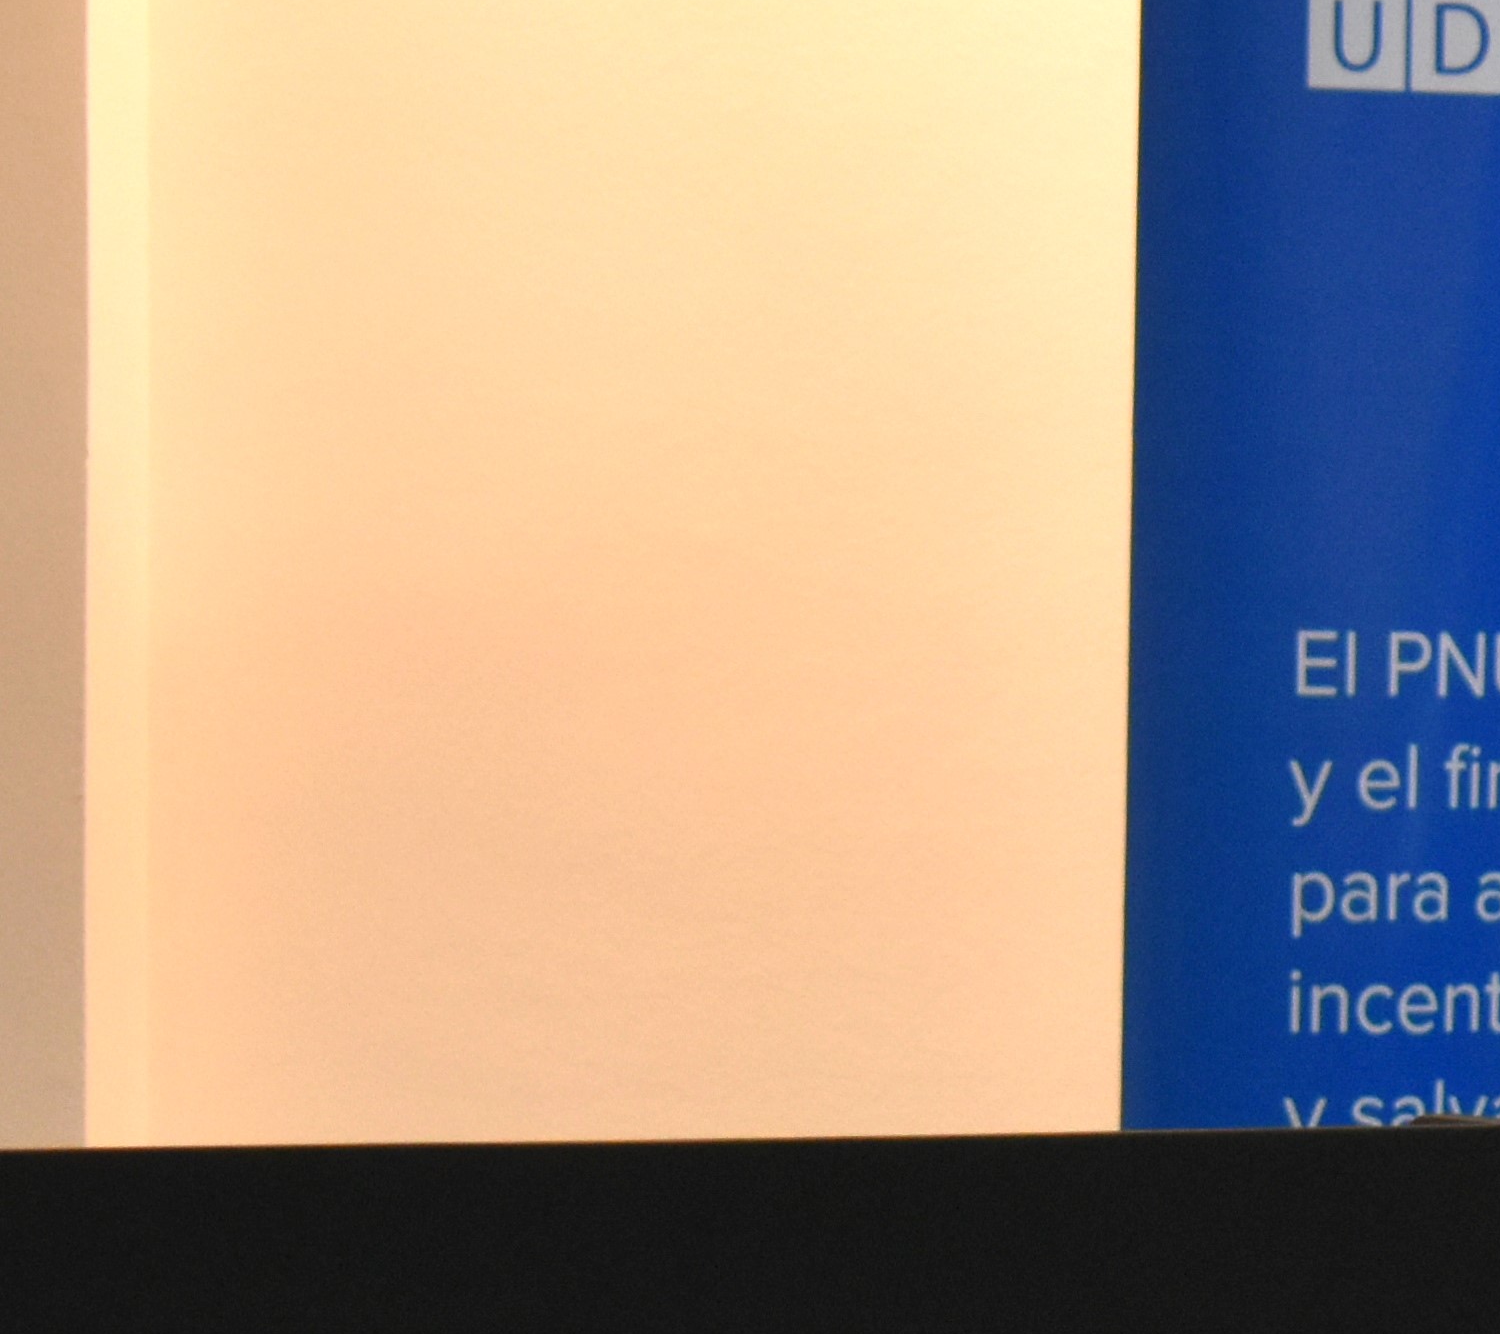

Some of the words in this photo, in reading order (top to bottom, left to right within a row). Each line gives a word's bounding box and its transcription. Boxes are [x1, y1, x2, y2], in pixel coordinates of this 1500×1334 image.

[1295, 629, 1357, 697] El
[1289, 759, 1333, 828] y
[1357, 743, 1419, 811] el
[1291, 871, 1449, 939] para
